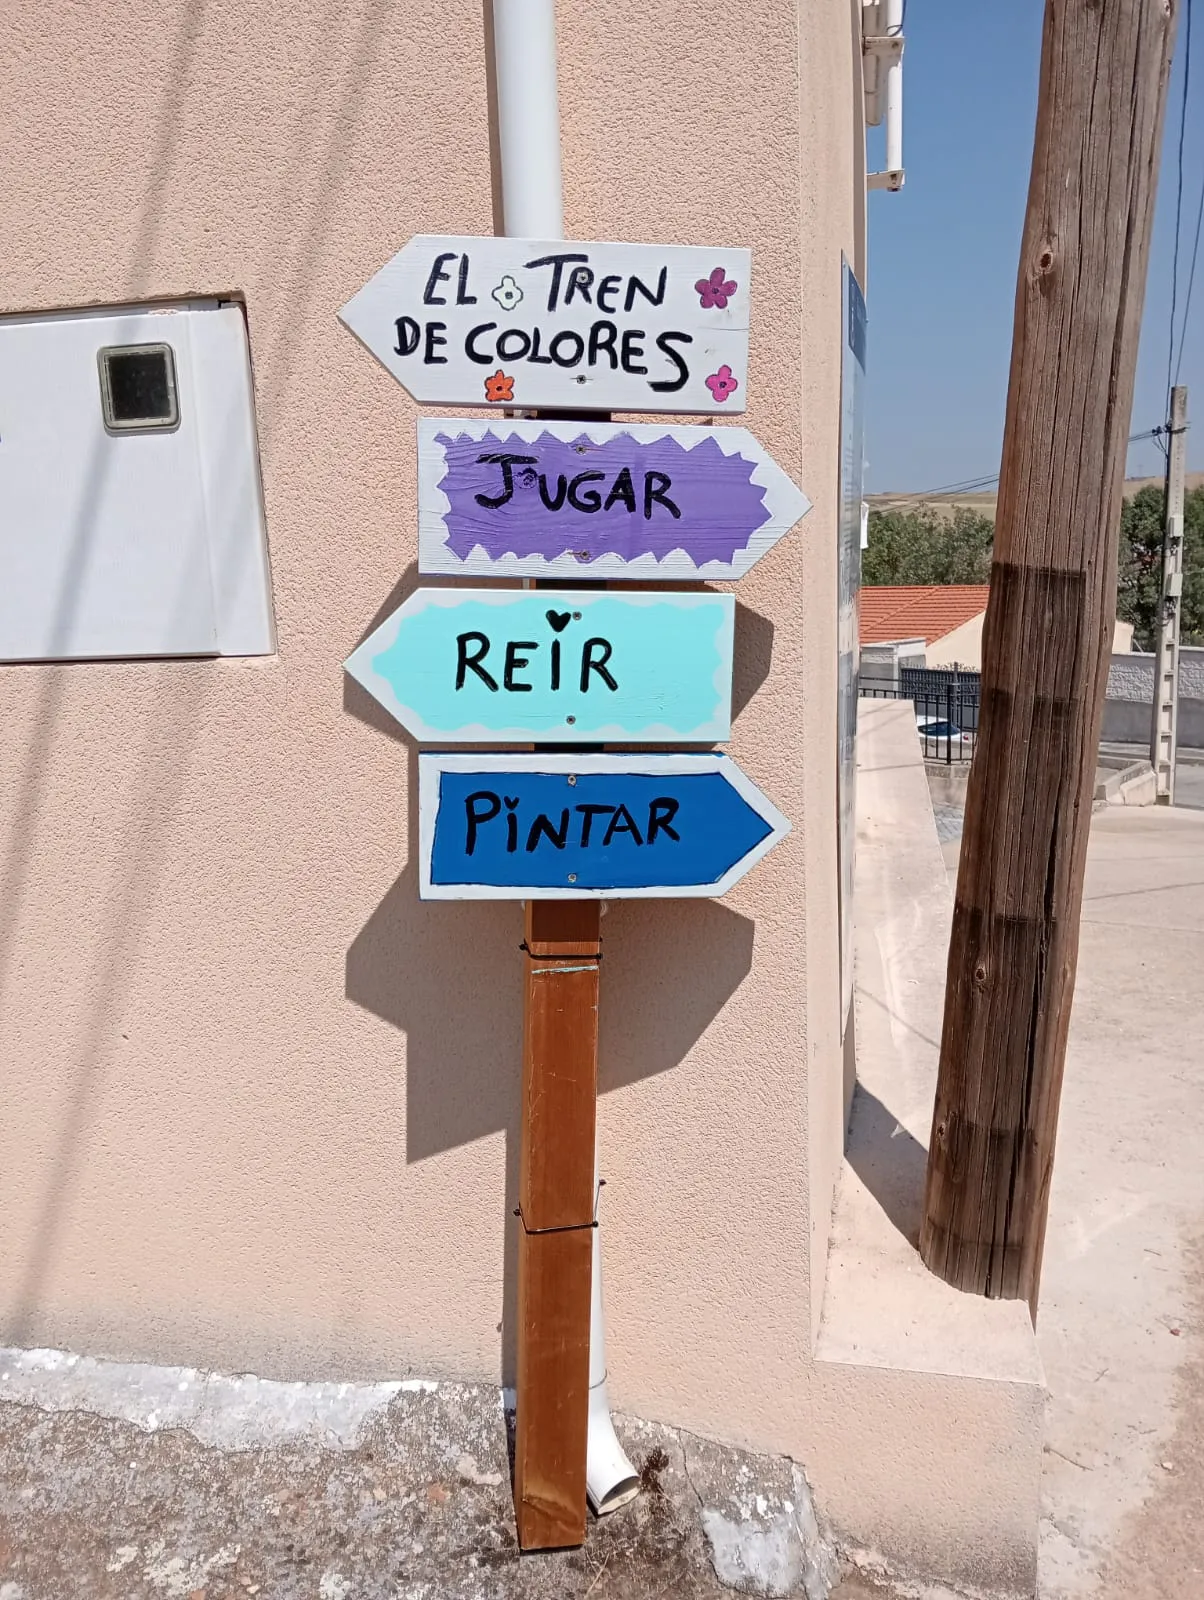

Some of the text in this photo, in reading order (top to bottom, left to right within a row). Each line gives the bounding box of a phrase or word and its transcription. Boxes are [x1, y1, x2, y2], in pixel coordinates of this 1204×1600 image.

[423, 252, 668, 314] EL TREN
[393, 316, 694, 393] DE COLORES
[474, 453, 682, 520] JUGAR
